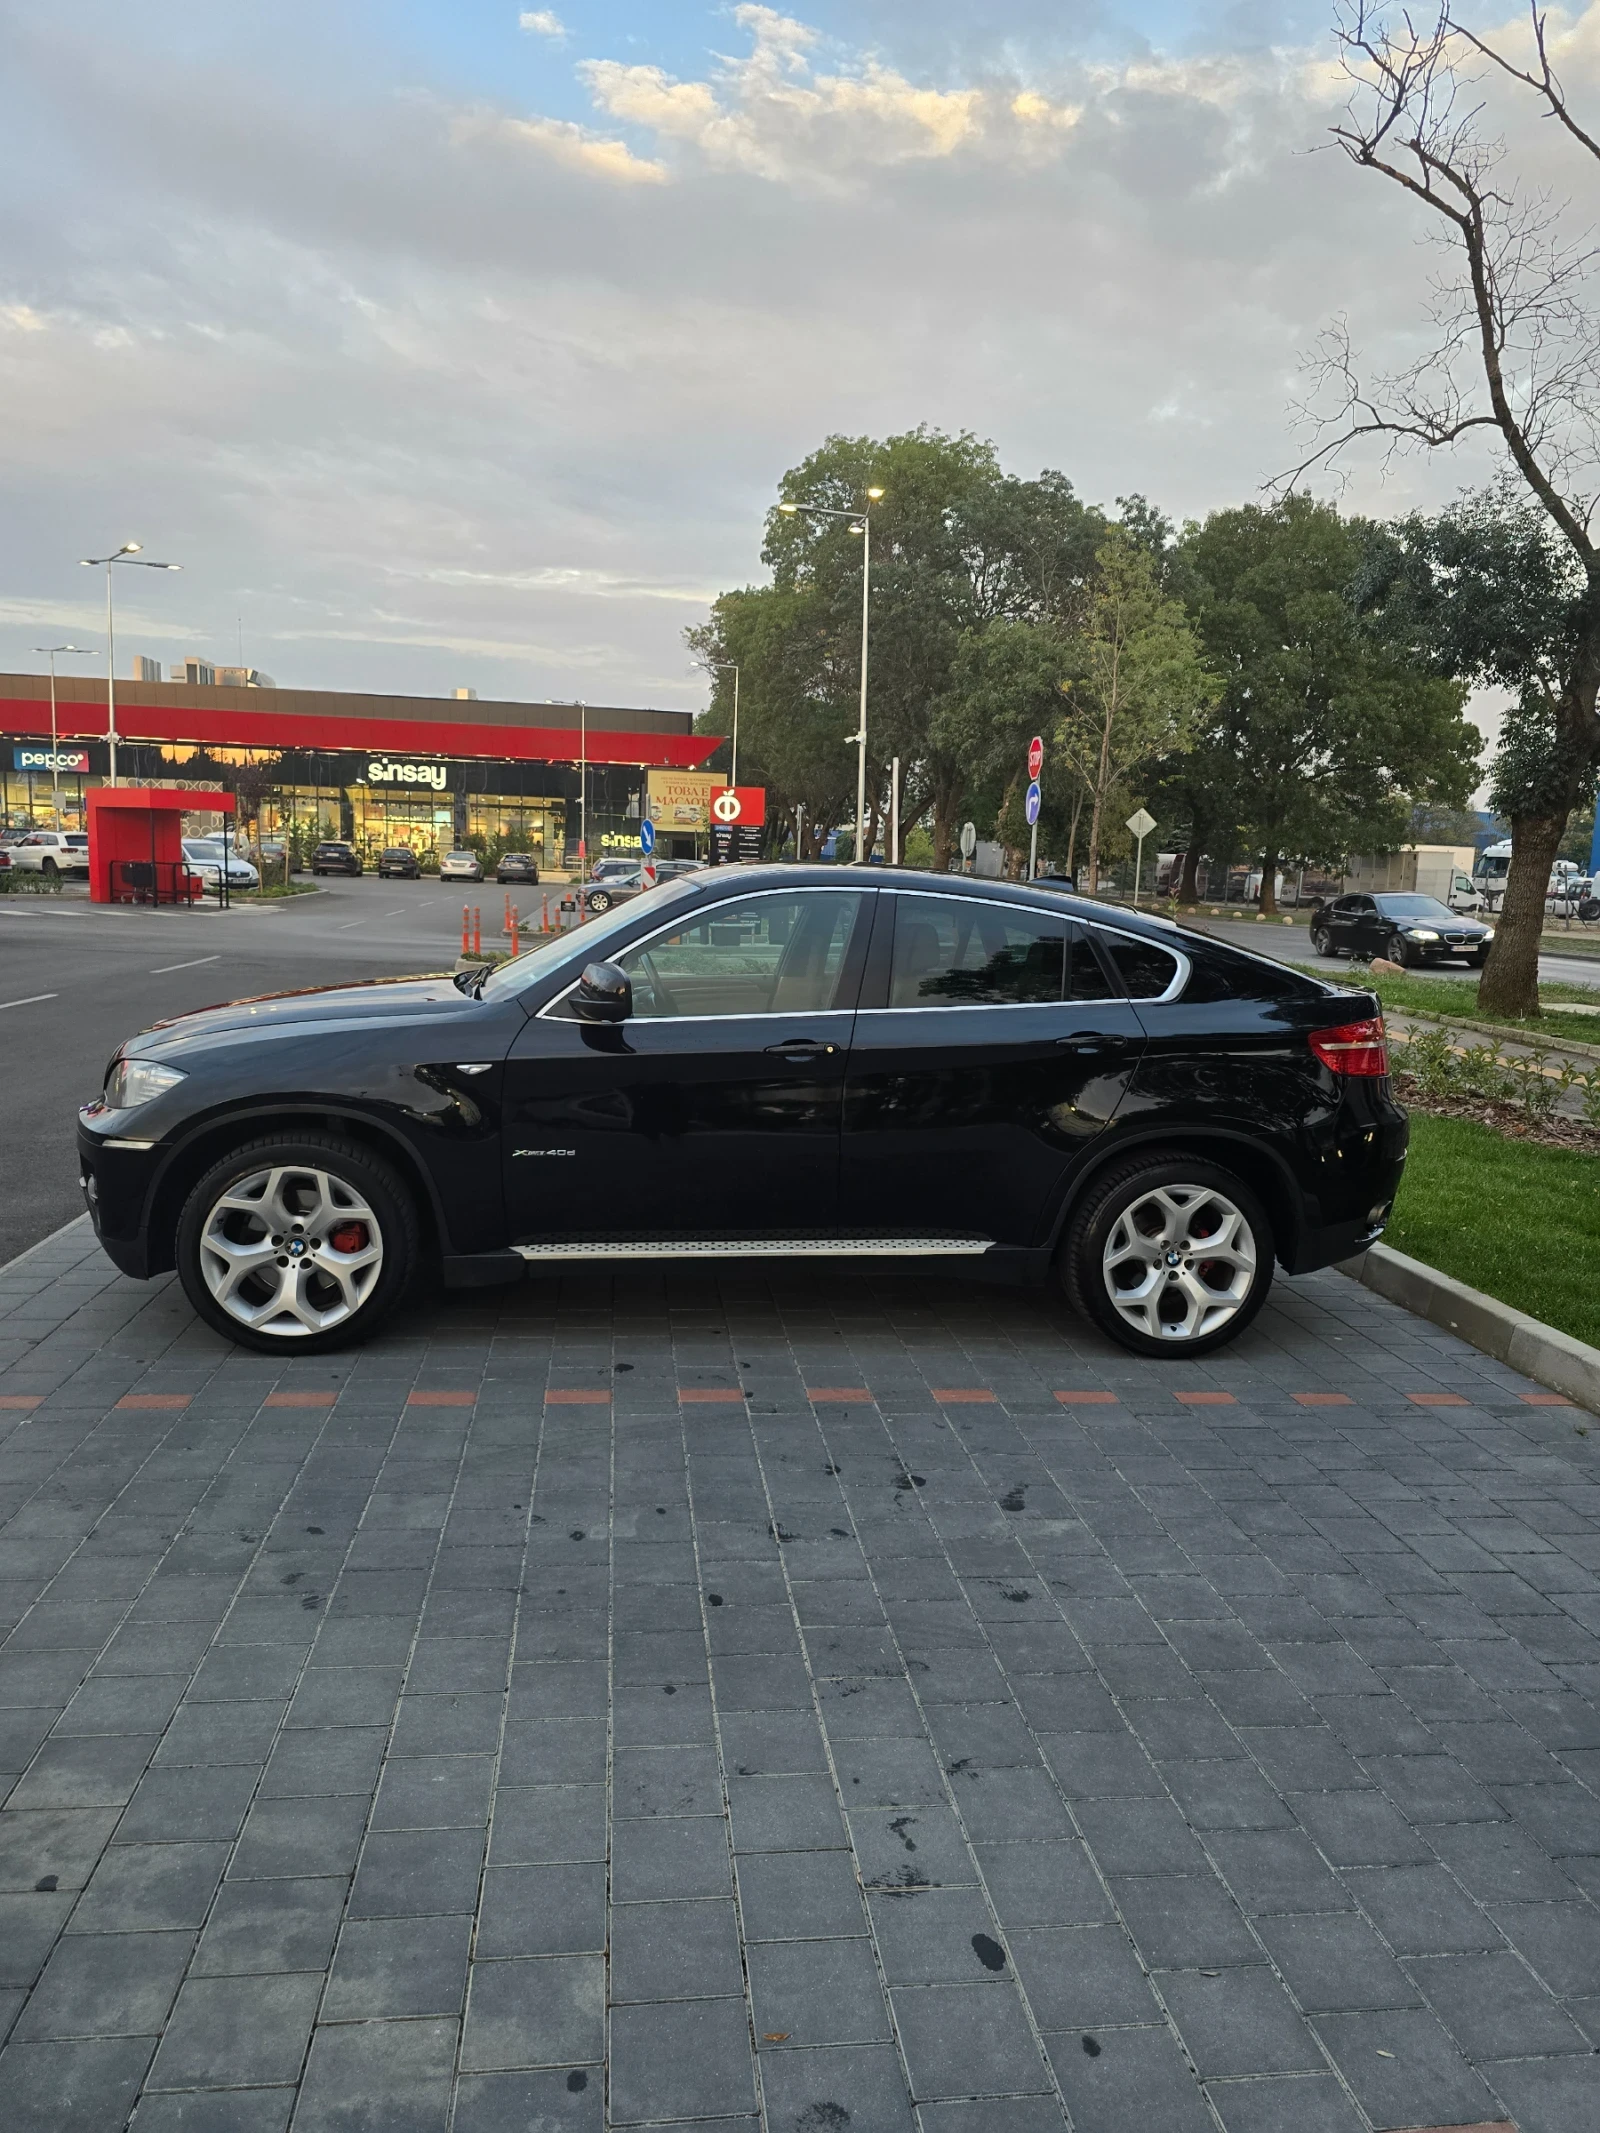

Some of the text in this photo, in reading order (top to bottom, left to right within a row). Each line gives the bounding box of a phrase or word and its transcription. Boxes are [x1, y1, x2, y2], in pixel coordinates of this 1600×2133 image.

[21, 752, 80, 768] pepco
[1030, 751, 1041, 767] STOP
[368, 758, 446, 790] sinsay
[665, 785, 709, 797] ТОВА Е
[601, 831, 642, 847] sinsa
